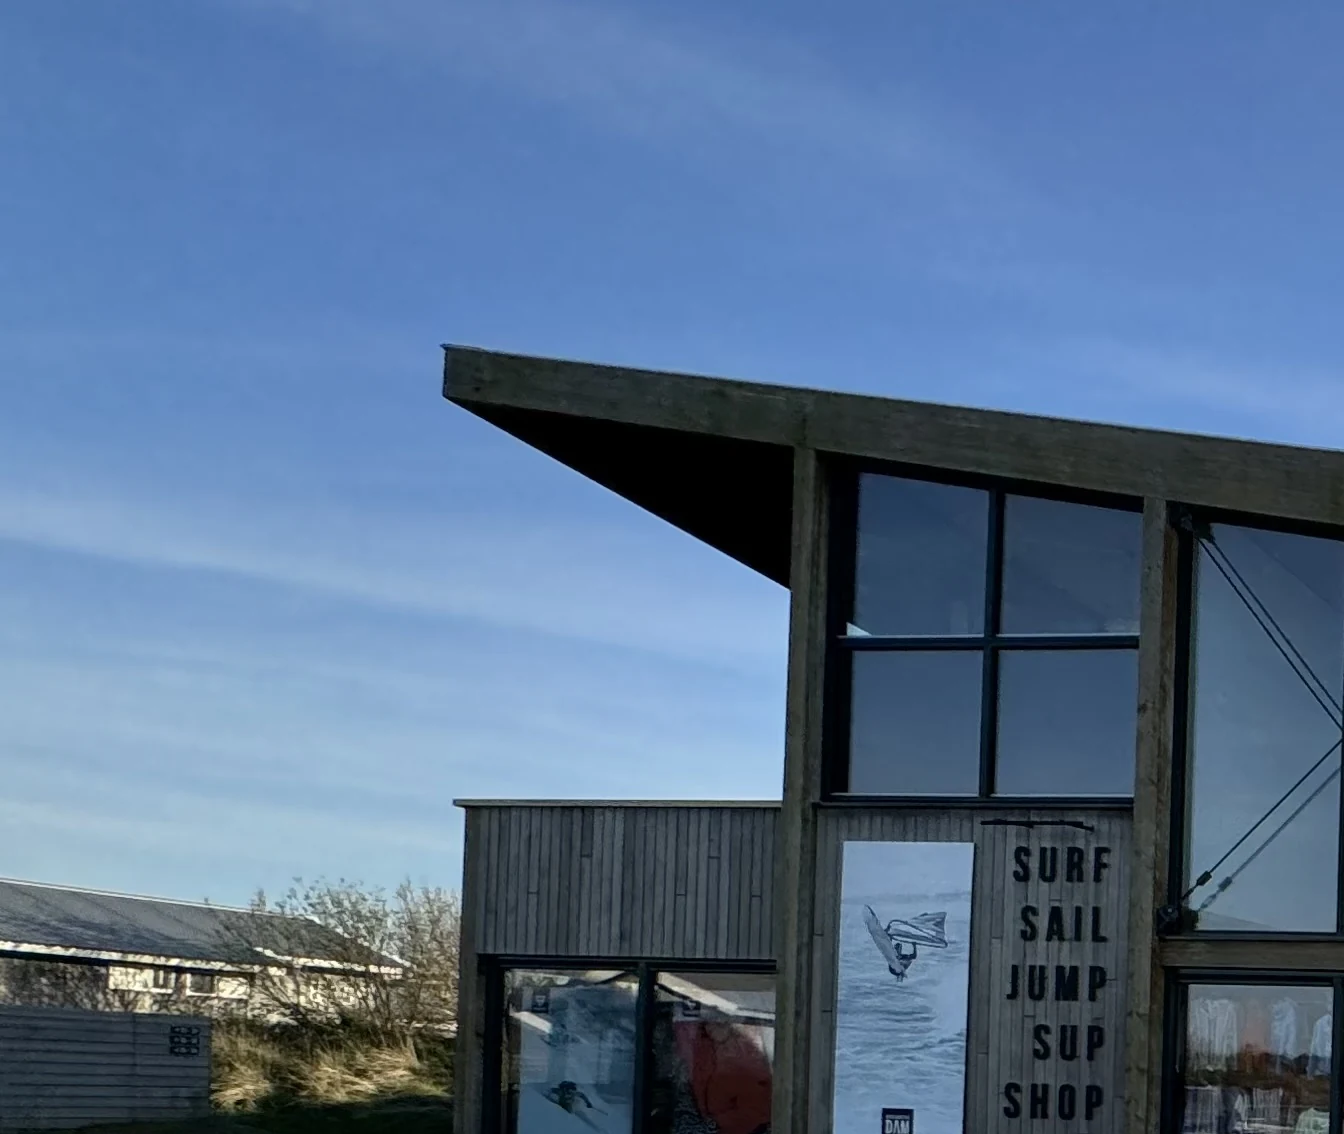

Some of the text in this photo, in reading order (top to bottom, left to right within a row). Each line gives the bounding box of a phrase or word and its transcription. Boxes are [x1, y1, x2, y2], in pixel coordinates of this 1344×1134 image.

[1013, 846, 1111, 883] SURF
[1020, 905, 1108, 942] SAIL
[1006, 964, 1107, 1002] JUMP
[1033, 1024, 1105, 1062] SUP
[1003, 1082, 1104, 1121] SHOP
